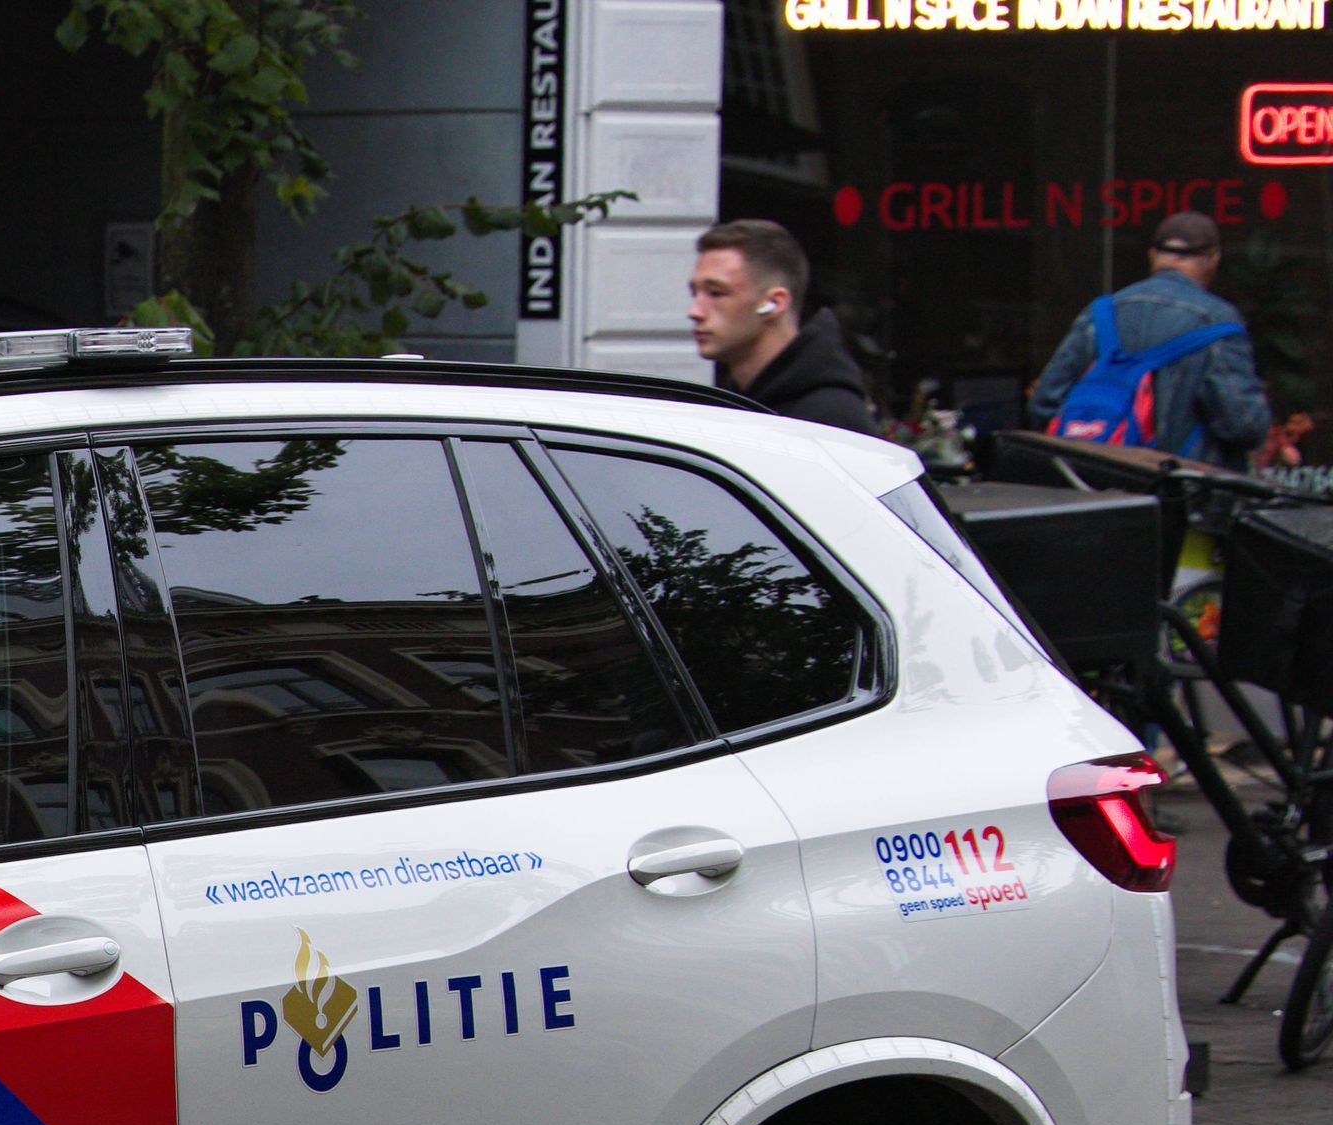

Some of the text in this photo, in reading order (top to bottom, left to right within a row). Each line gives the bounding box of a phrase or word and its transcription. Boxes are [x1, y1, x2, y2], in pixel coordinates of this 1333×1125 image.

[785, 0, 1326, 31] GRILL N SPICE INDIAN RESTAURANT
[1252, 105, 1333, 145] OPEN
[879, 179, 1245, 230] GRILL N SPICE
[527, 161, 556, 312] INDAN
[876, 831, 941, 864] 0900
[944, 825, 1015, 875] 112
[364, 865, 393, 889] en
[886, 863, 955, 894] 8844
[965, 875, 1028, 910] spoed
[899, 893, 965, 917] geen spoed
[240, 965, 575, 1093] POLITIE
